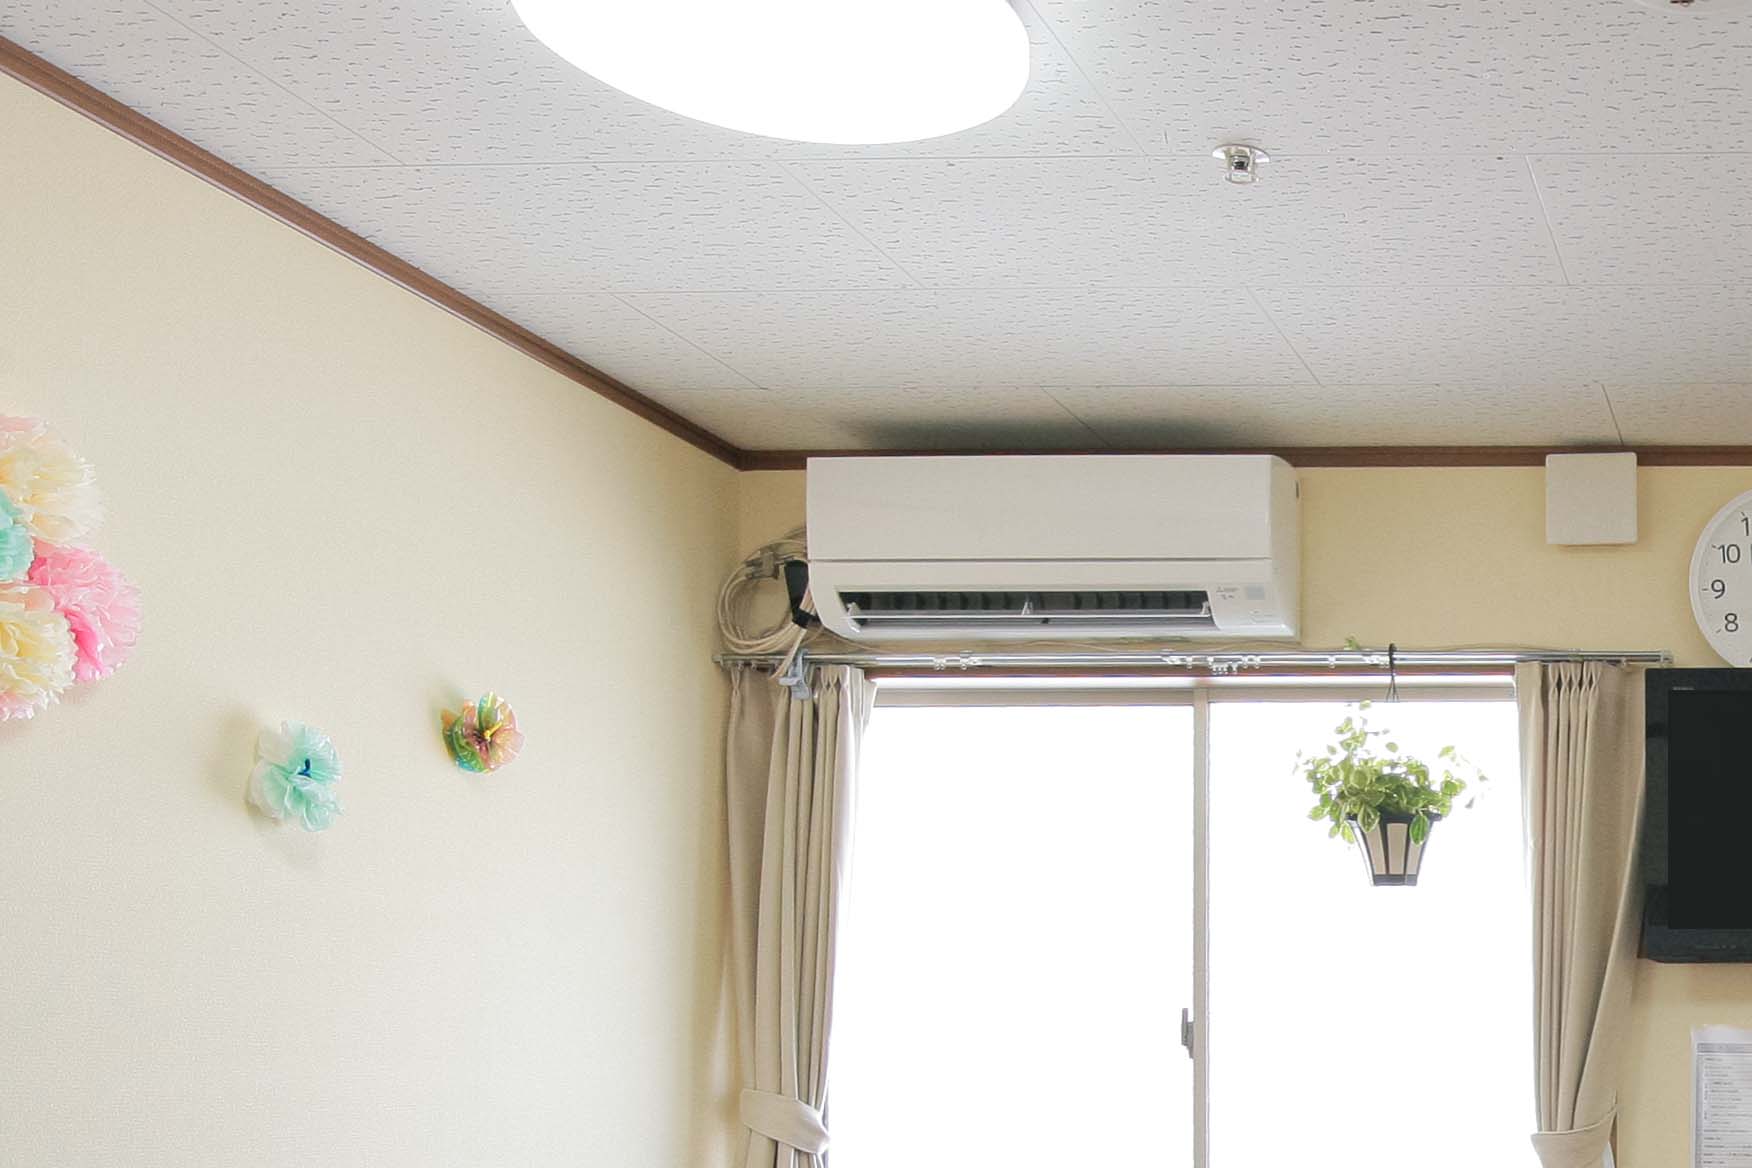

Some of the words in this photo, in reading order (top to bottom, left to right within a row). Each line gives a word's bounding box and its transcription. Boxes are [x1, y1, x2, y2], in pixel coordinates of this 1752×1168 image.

[1719, 544, 1741, 563] 10
[1711, 580, 1725, 599] 9
[1724, 613, 1739, 632] 8
